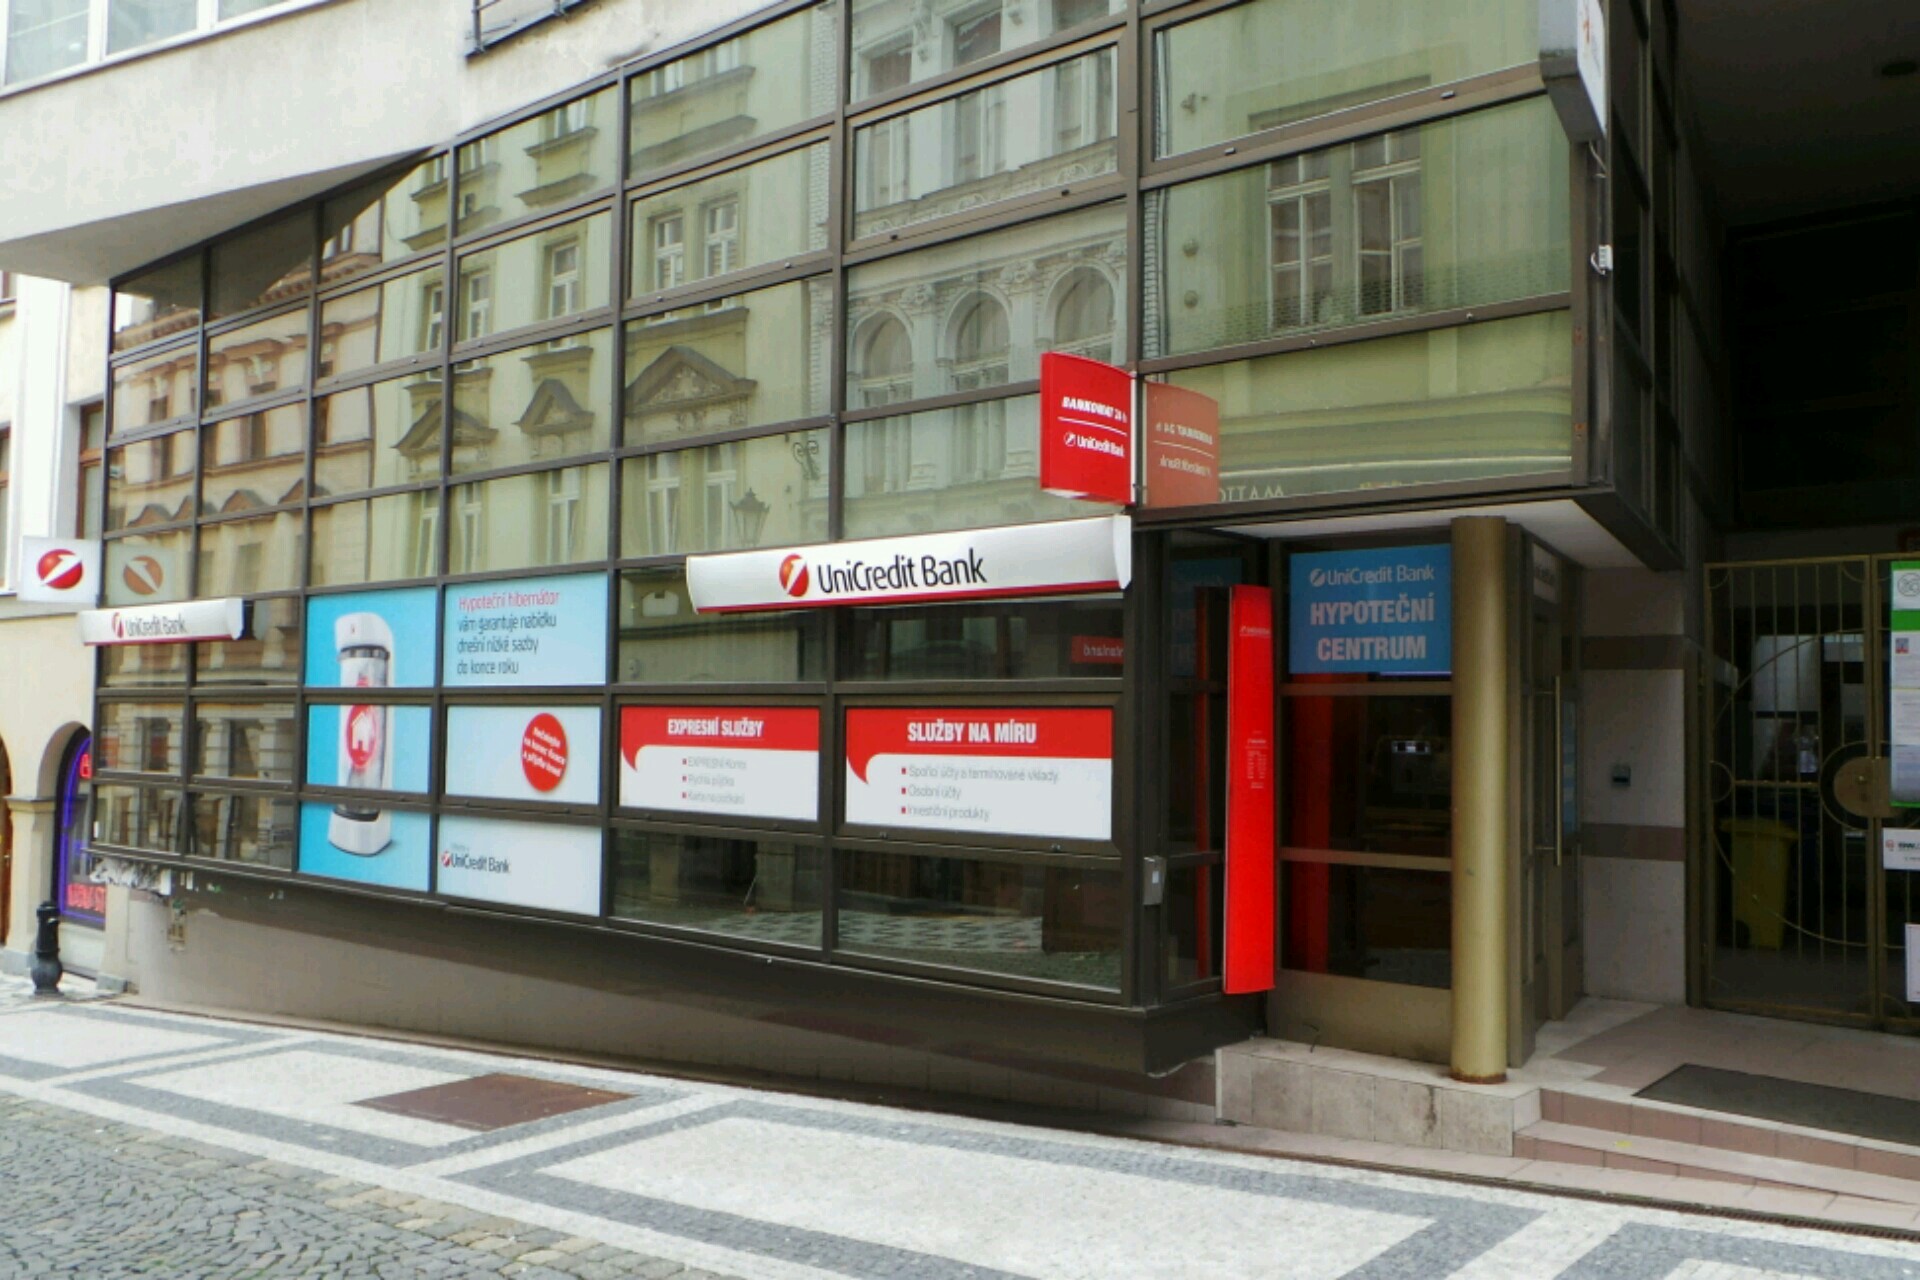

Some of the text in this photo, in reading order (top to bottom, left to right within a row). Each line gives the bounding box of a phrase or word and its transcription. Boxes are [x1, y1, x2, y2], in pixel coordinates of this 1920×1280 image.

[1077, 434, 1111, 453] UniCredit
[817, 547, 988, 594] UniCredit Bank
[1327, 563, 1435, 586] UniCredit Bank
[1310, 592, 1436, 626] HYPOTEČNÍ
[125, 611, 188, 637] UniCredit Bank
[1317, 635, 1427, 661] CENTRUM
[498, 658, 520, 674] roku
[668, 716, 764, 738] EXPRESNÍ SLUŽBY
[907, 718, 1037, 744] SLUŽBY NA MÍRU
[451, 852, 511, 875] UniCredit Bank
